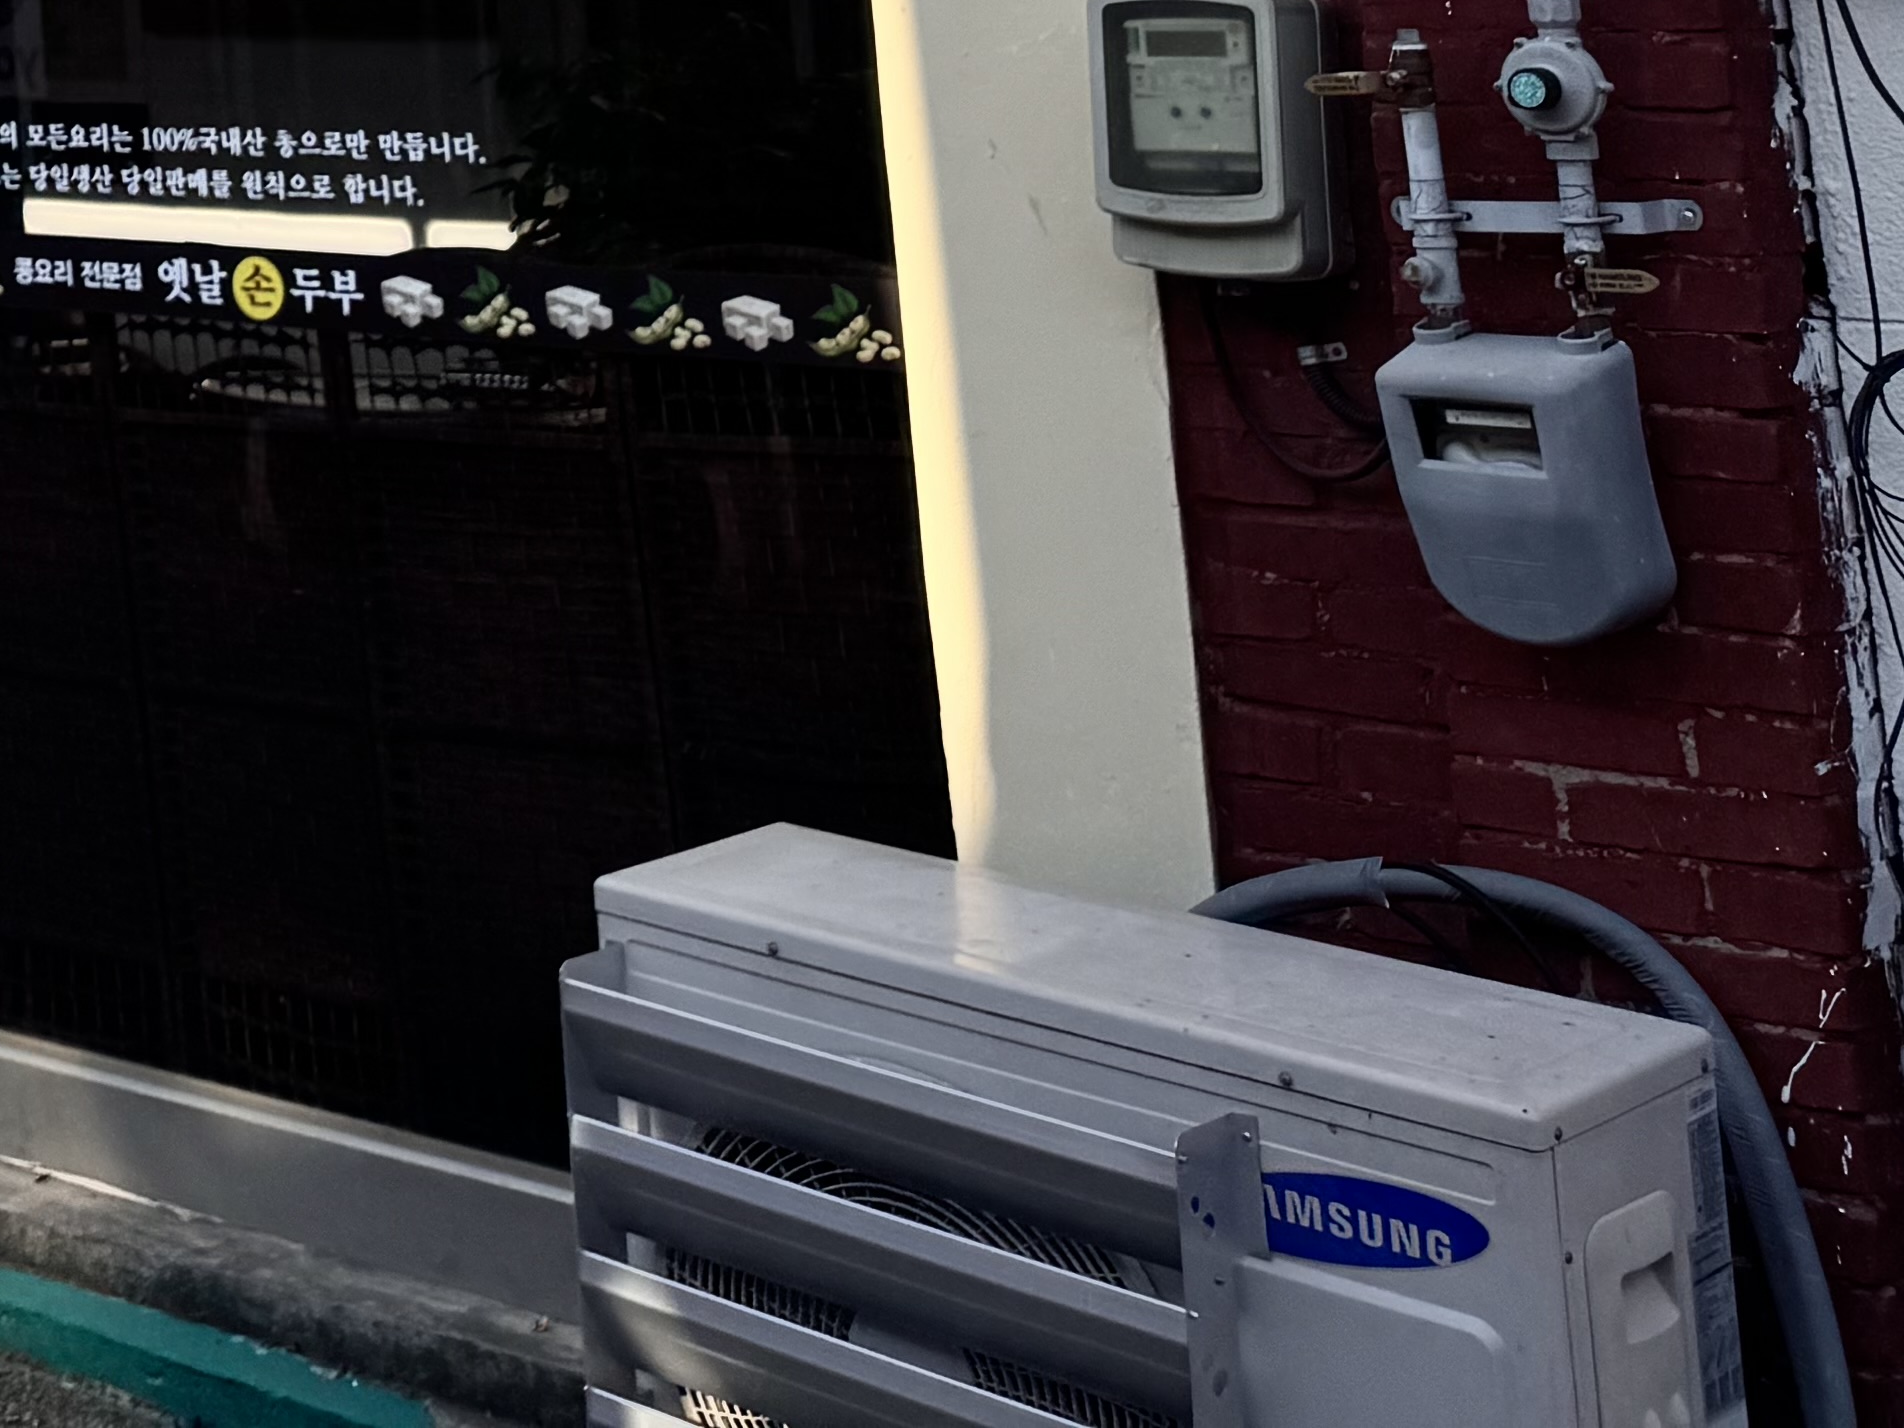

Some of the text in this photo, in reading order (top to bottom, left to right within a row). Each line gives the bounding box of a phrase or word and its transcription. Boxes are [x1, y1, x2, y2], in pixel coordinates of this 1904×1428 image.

[25, 122, 133, 153] 모든요리는
[140, 126, 267, 157] 100%국내산
[274, 129, 370, 160] 콩으로만
[378, 130, 487, 165] 만듭니다.
[29, 162, 113, 194] 당일생산
[121, 165, 232, 199] 당일판매를
[241, 170, 335, 201] 원칙으로
[344, 173, 424, 207] 합니다.
[13, 257, 364, 316] 콩요리 전문점 옛날 손 두부
[1264, 1183, 1453, 1267] MSUNG
